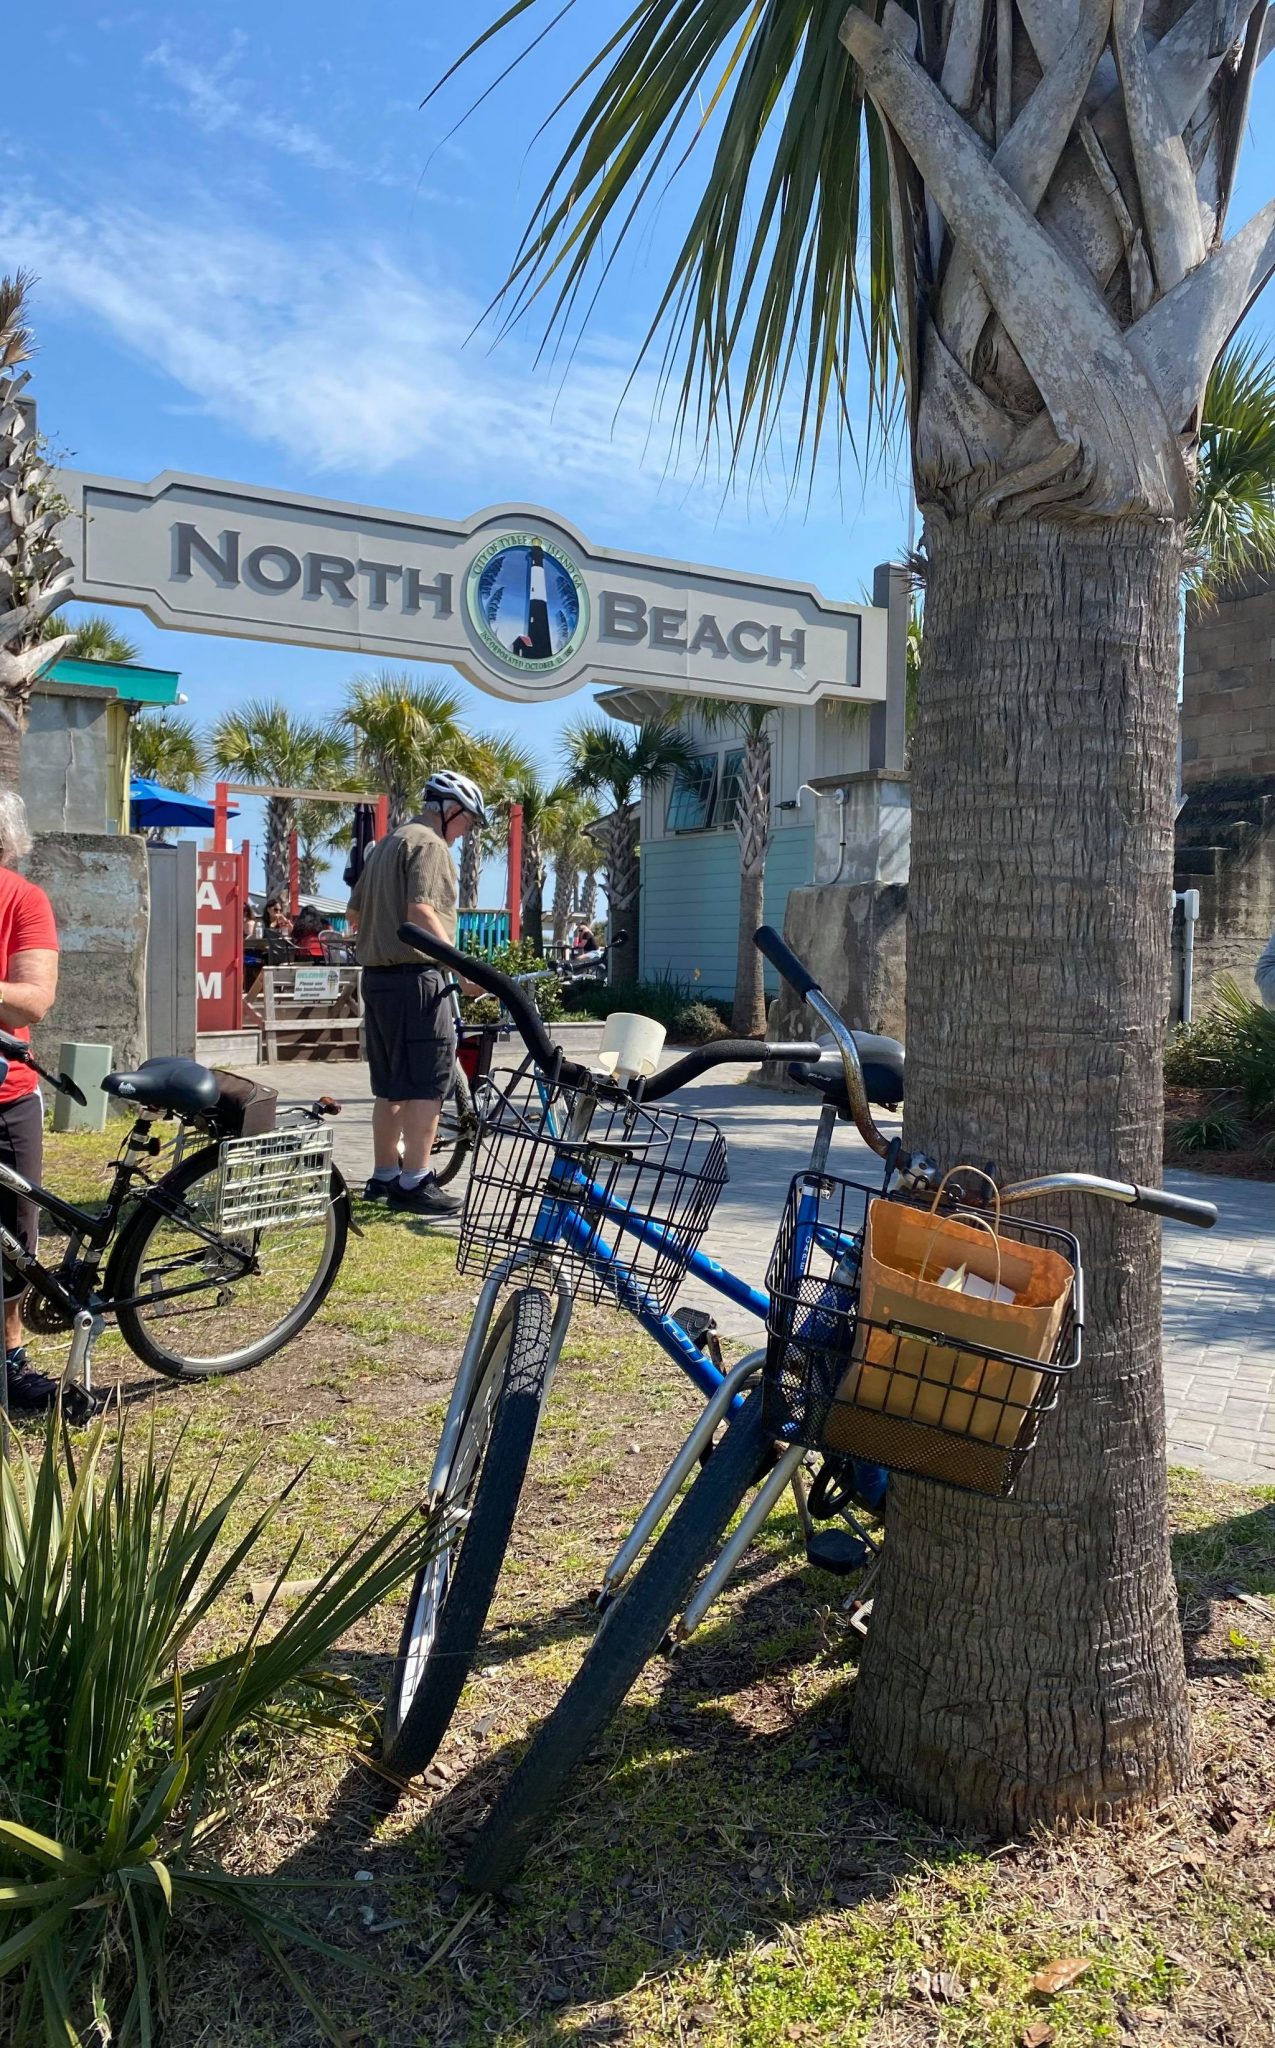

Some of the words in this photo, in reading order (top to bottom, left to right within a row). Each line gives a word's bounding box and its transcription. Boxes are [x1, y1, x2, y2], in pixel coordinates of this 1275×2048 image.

[176, 521, 453, 616] NORTH
[603, 589, 808, 668] BEACH
[473, 553, 490, 575] CITY
[487, 545, 499, 557] OF
[498, 535, 528, 548] TYBEE
[547, 544, 576, 575] ISLAND
[196, 881, 222, 1000] ATM
